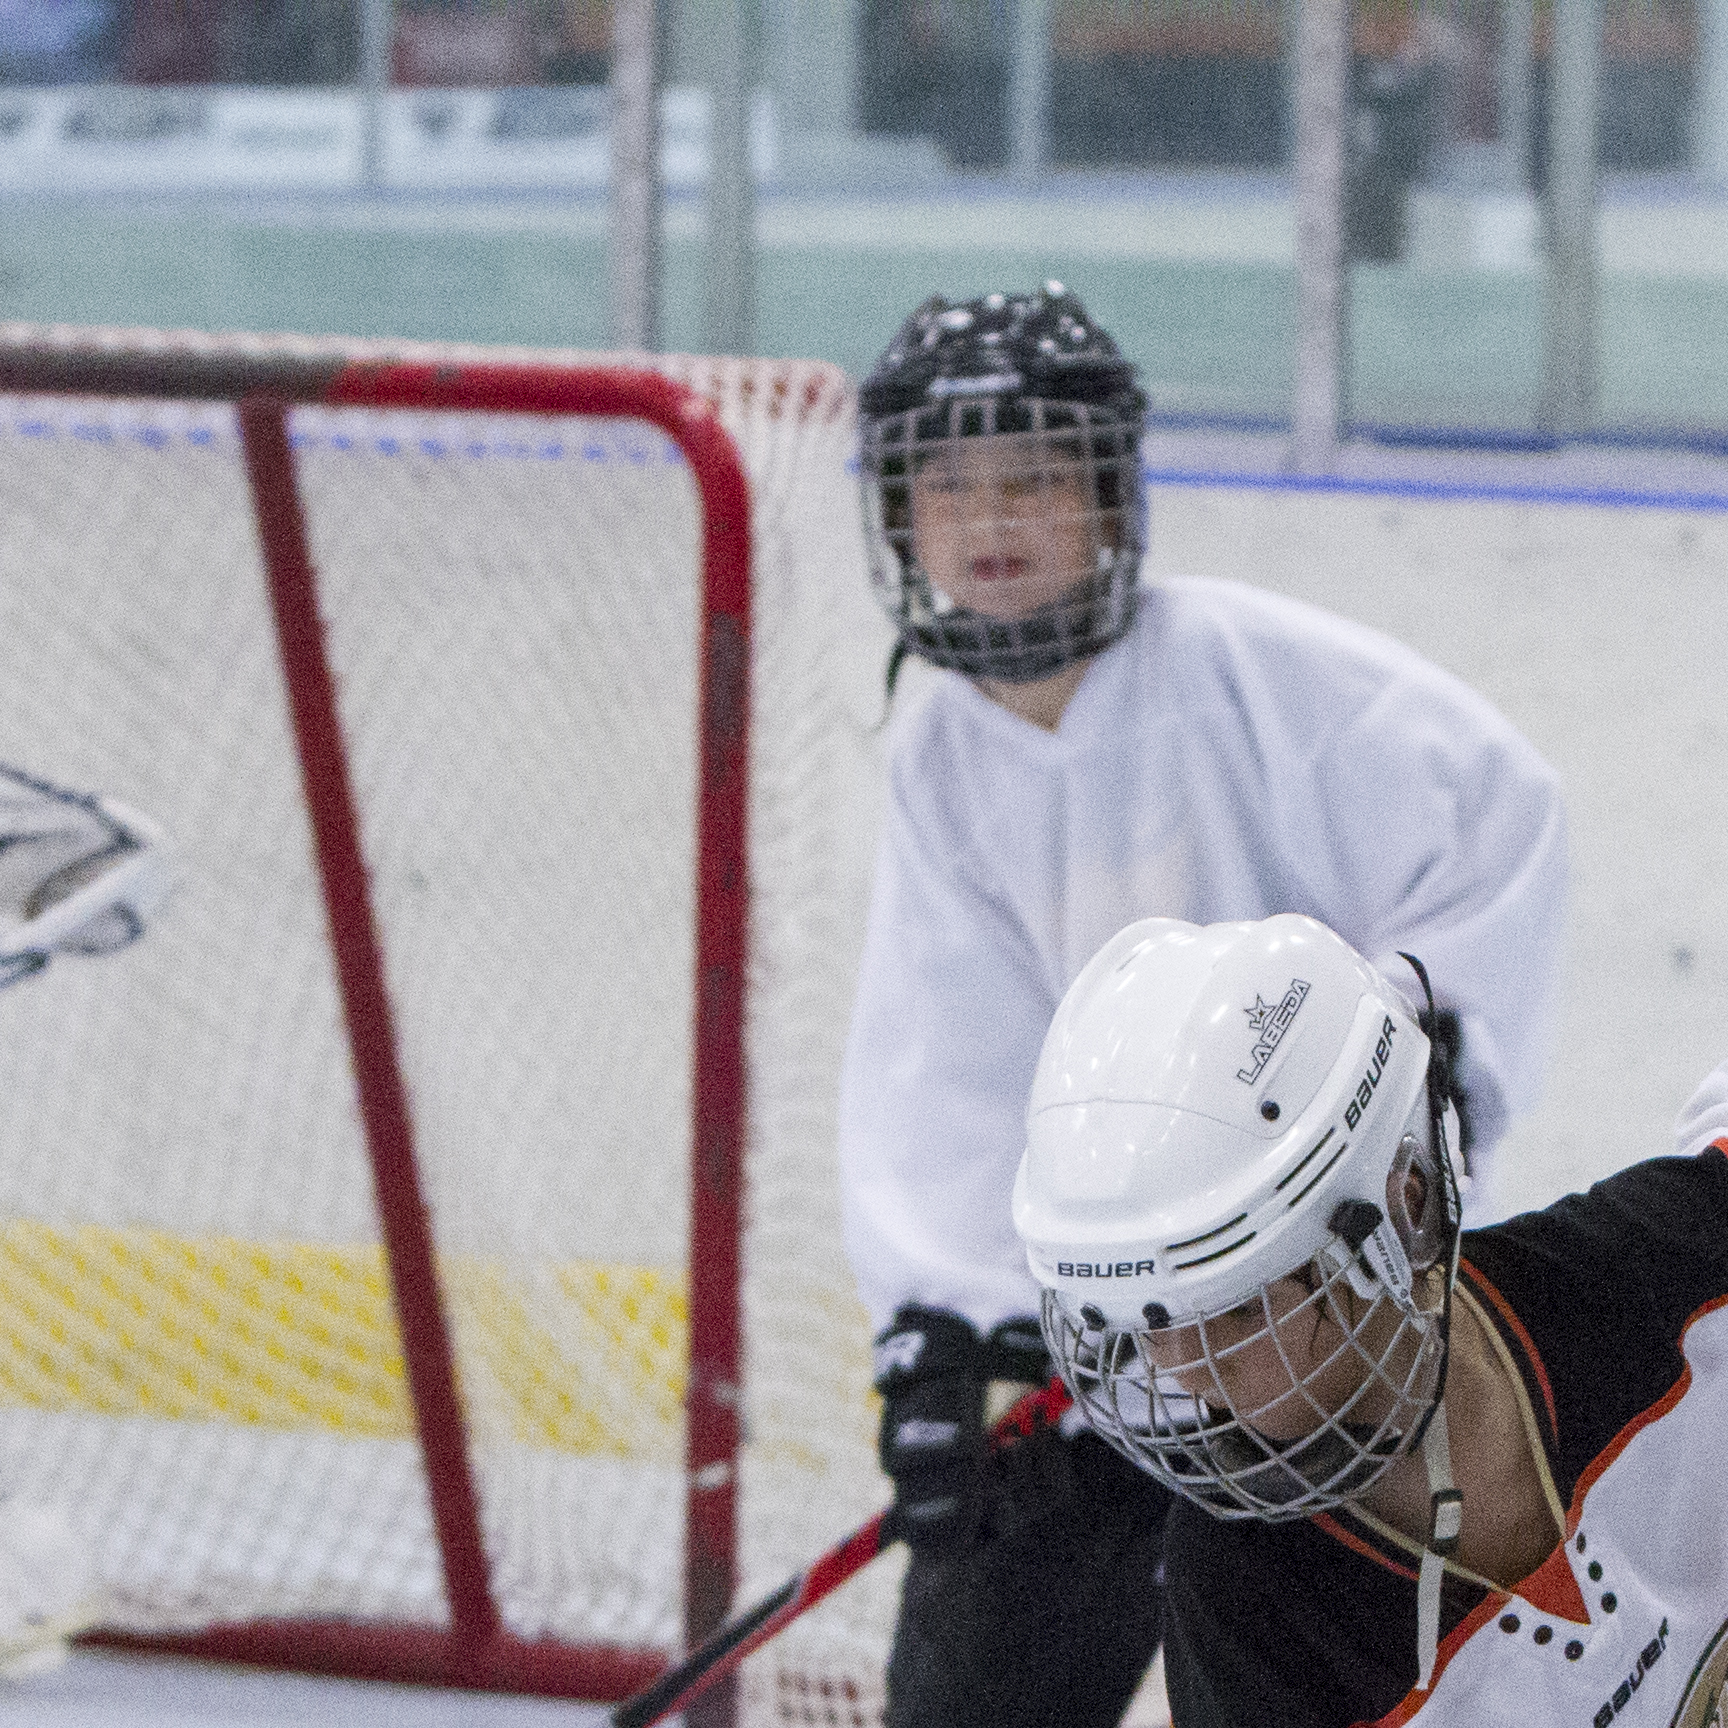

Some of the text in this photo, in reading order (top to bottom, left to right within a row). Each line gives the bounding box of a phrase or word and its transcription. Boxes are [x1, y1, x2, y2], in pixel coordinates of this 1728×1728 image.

[1235, 977, 1312, 1086] LABEDA
[1344, 1014, 1398, 1132] BAUER
[1057, 1258, 1156, 1278] BAUER
